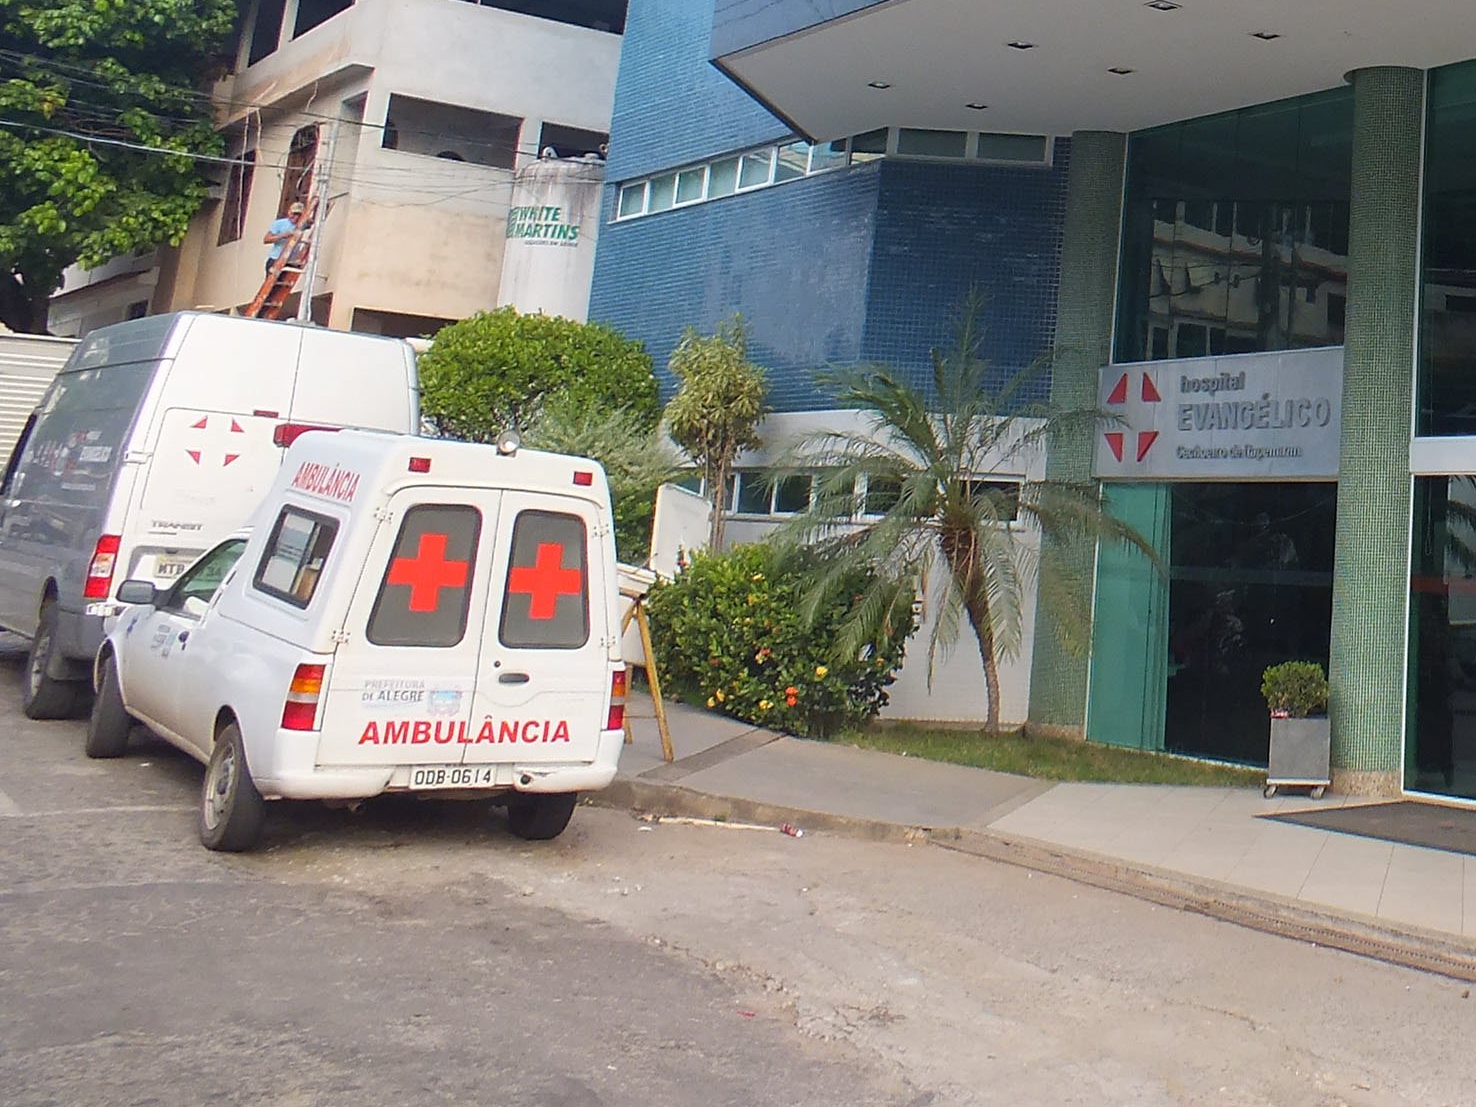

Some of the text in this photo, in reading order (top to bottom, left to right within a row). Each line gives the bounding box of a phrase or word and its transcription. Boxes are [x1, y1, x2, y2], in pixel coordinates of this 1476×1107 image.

[518, 205, 562, 222] WHITE
[513, 223, 580, 240] MARTINS
[1180, 371, 1246, 396] hospital
[1177, 393, 1332, 431] EVANGÉLICO
[291, 461, 361, 503] AMBULÂNCIA
[150, 520, 204, 531] TRANSIT
[364, 679, 426, 690] PREFEITURA
[377, 690, 426, 702] ALEGRE
[357, 714, 571, 745] AMBULÂNCIA
[414, 768, 492, 785] ODB-0614
